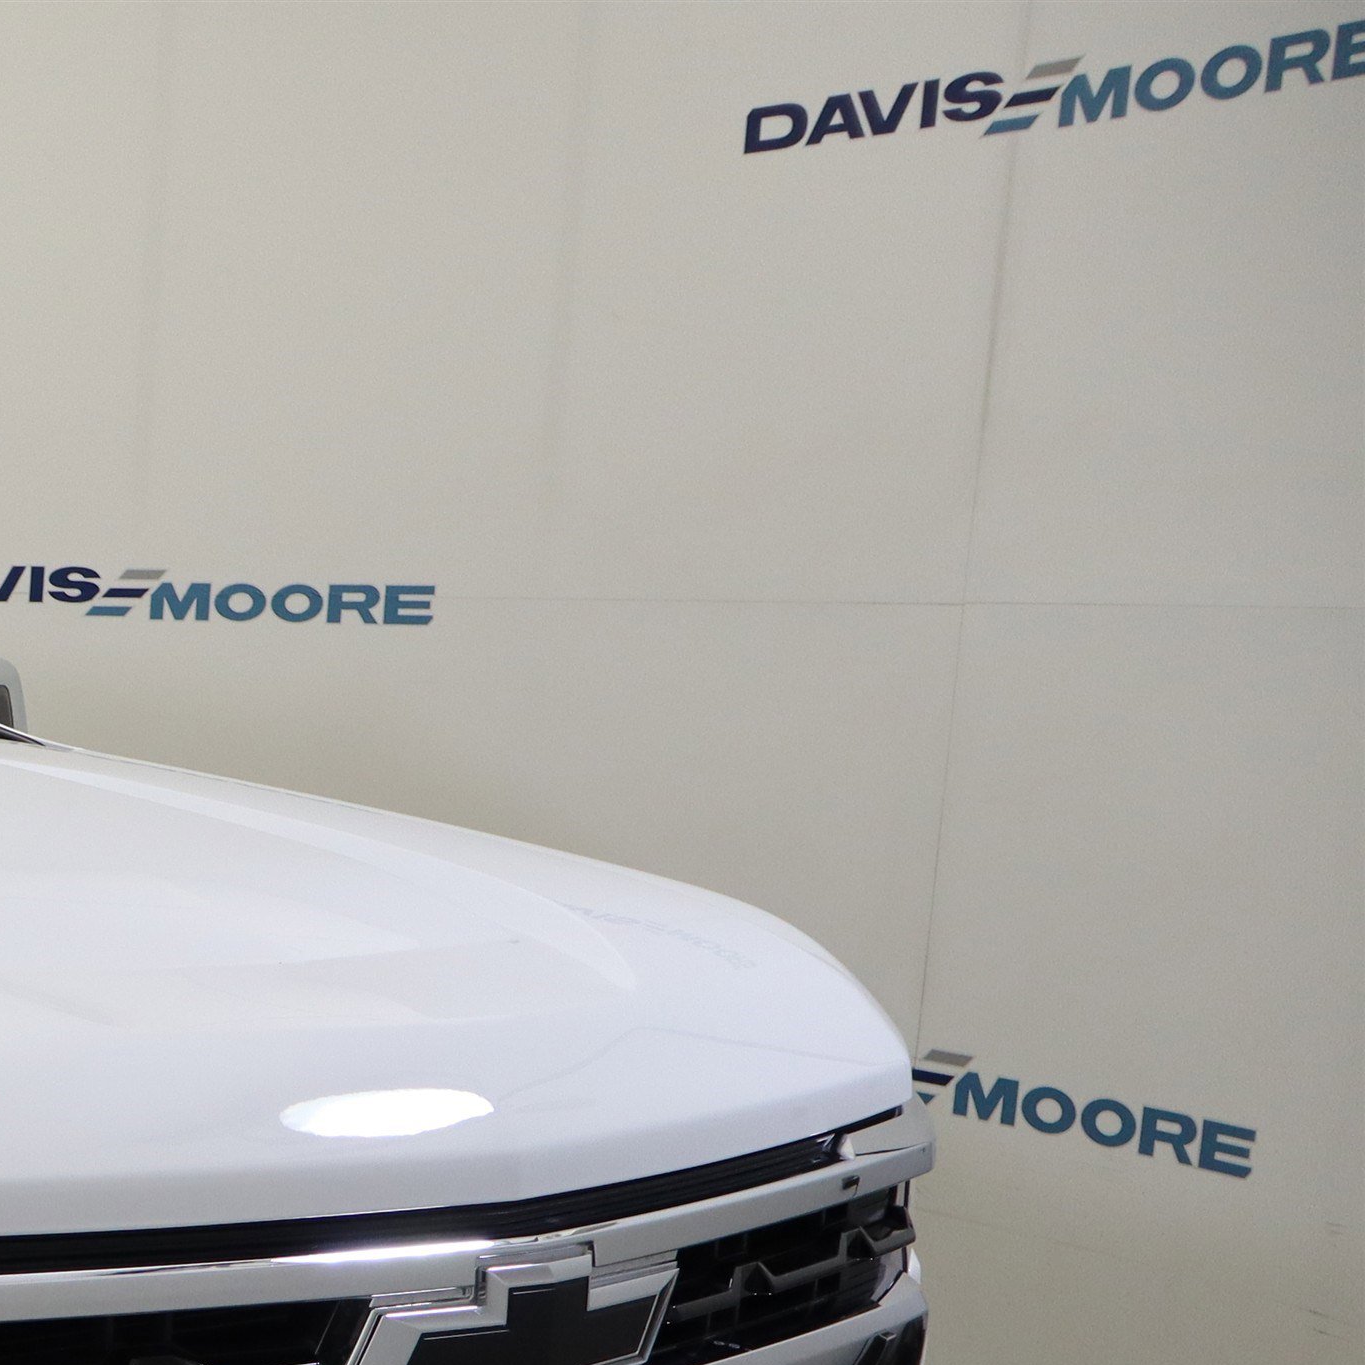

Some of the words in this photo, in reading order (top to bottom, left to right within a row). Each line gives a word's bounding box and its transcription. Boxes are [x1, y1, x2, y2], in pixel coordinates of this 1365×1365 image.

[743, 71, 1004, 155] DAVIS
[1057, 19, 1365, 130] MOORE
[149, 583, 435, 625] MOORE
[952, 1071, 1257, 1179] MOORE
